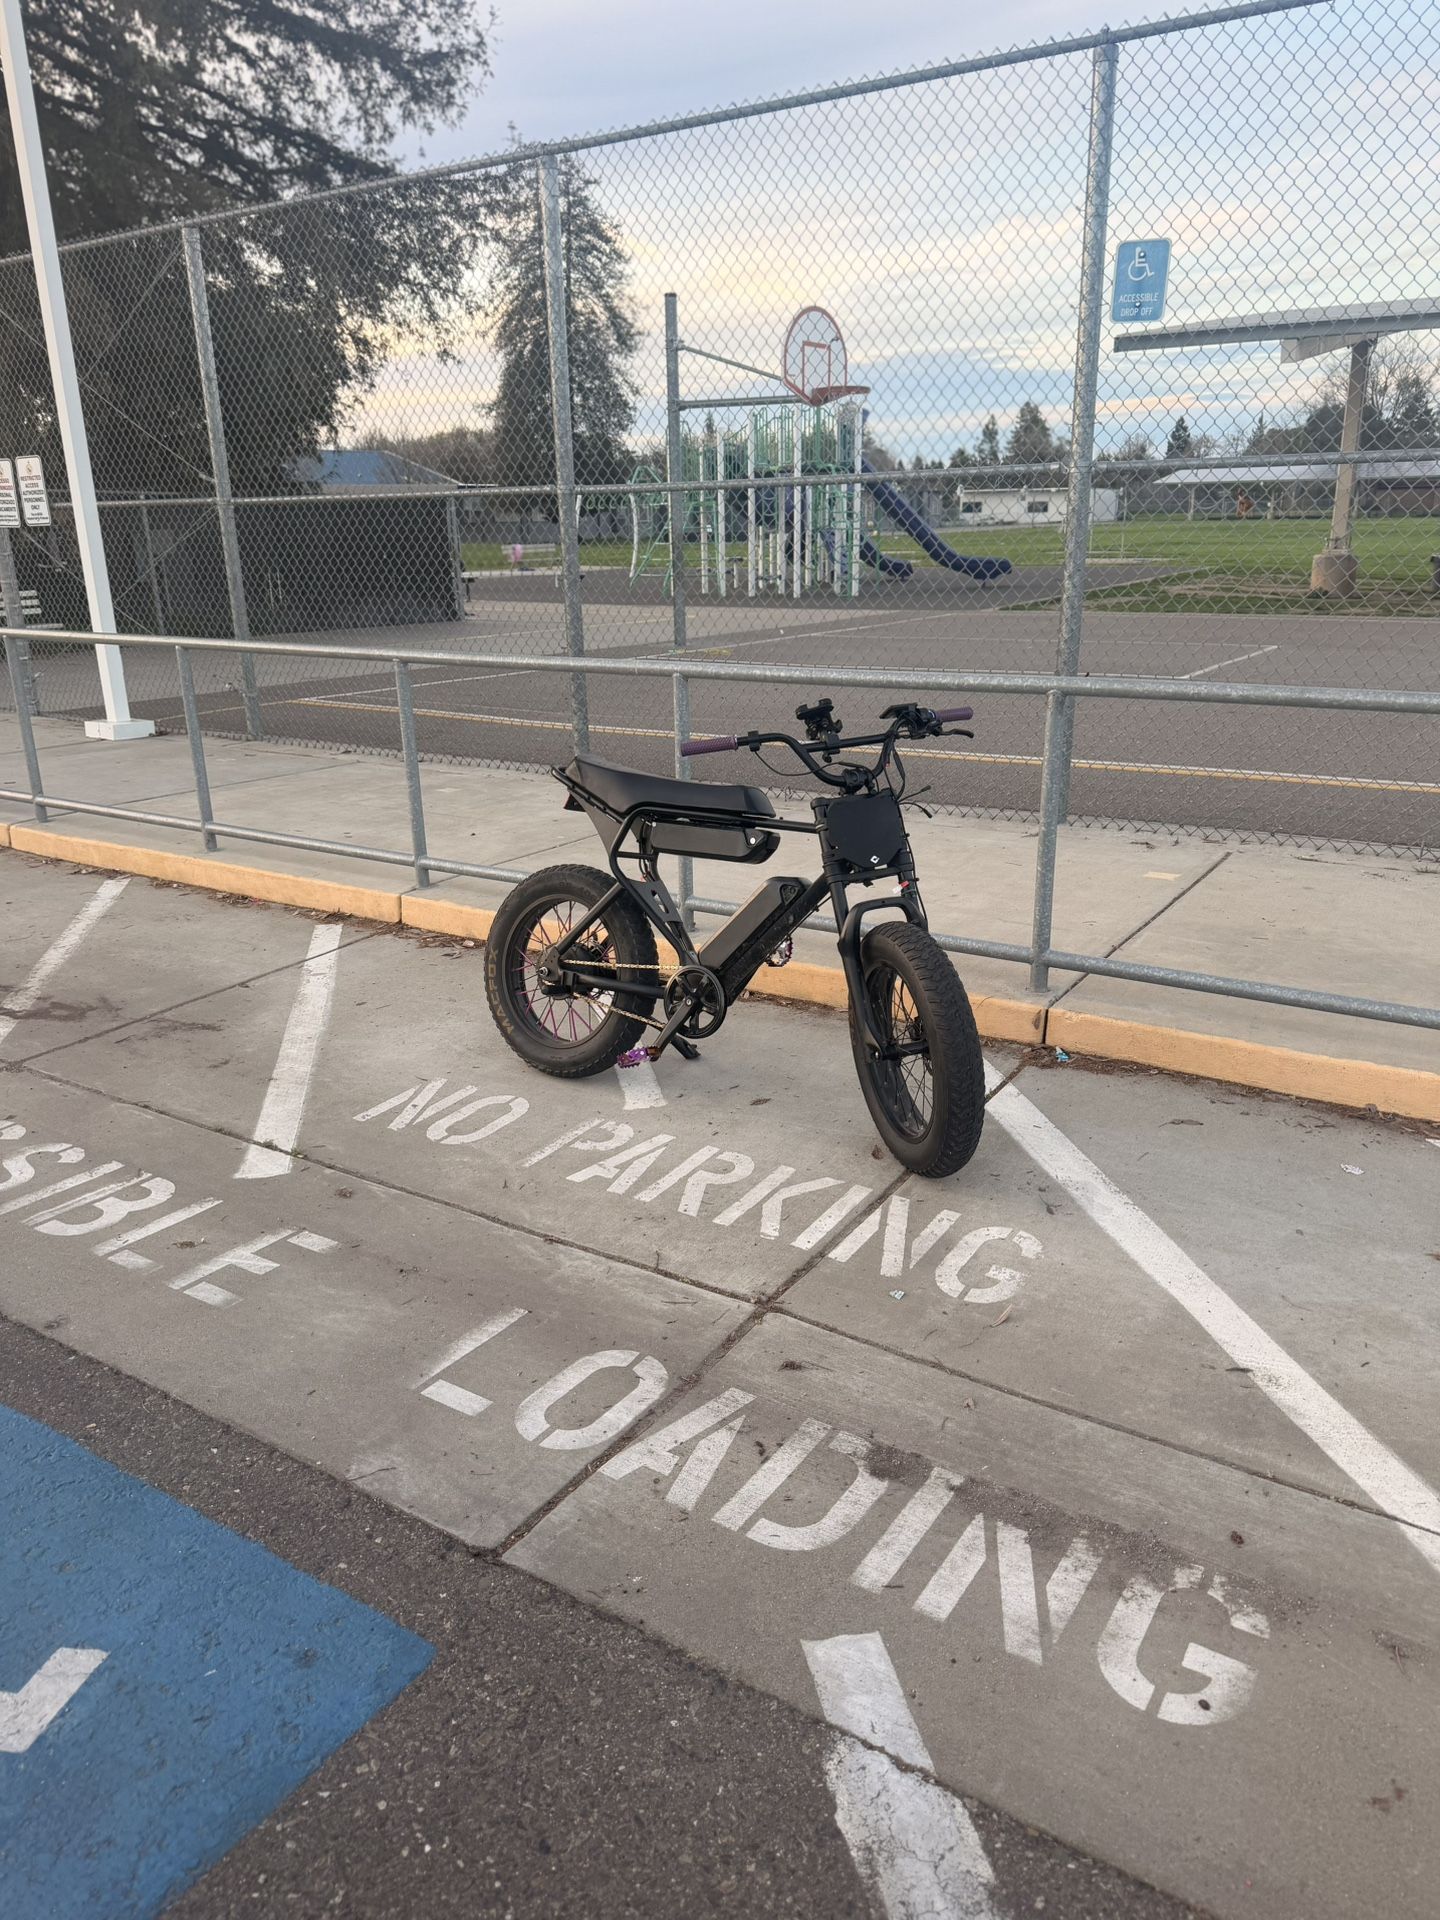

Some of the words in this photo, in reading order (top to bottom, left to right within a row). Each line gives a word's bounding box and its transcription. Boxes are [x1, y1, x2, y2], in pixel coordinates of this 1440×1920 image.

[1119, 292, 1159, 302] ACCESSIBLE
[1120, 308, 1139, 317] DROP
[1140, 307, 1153, 316] OFF
[0, 1119, 341, 1309] SIBLE
[353, 1077, 530, 1146] NO
[522, 1117, 1046, 1305] PARKING
[411, 1307, 1272, 1727] LOADING
